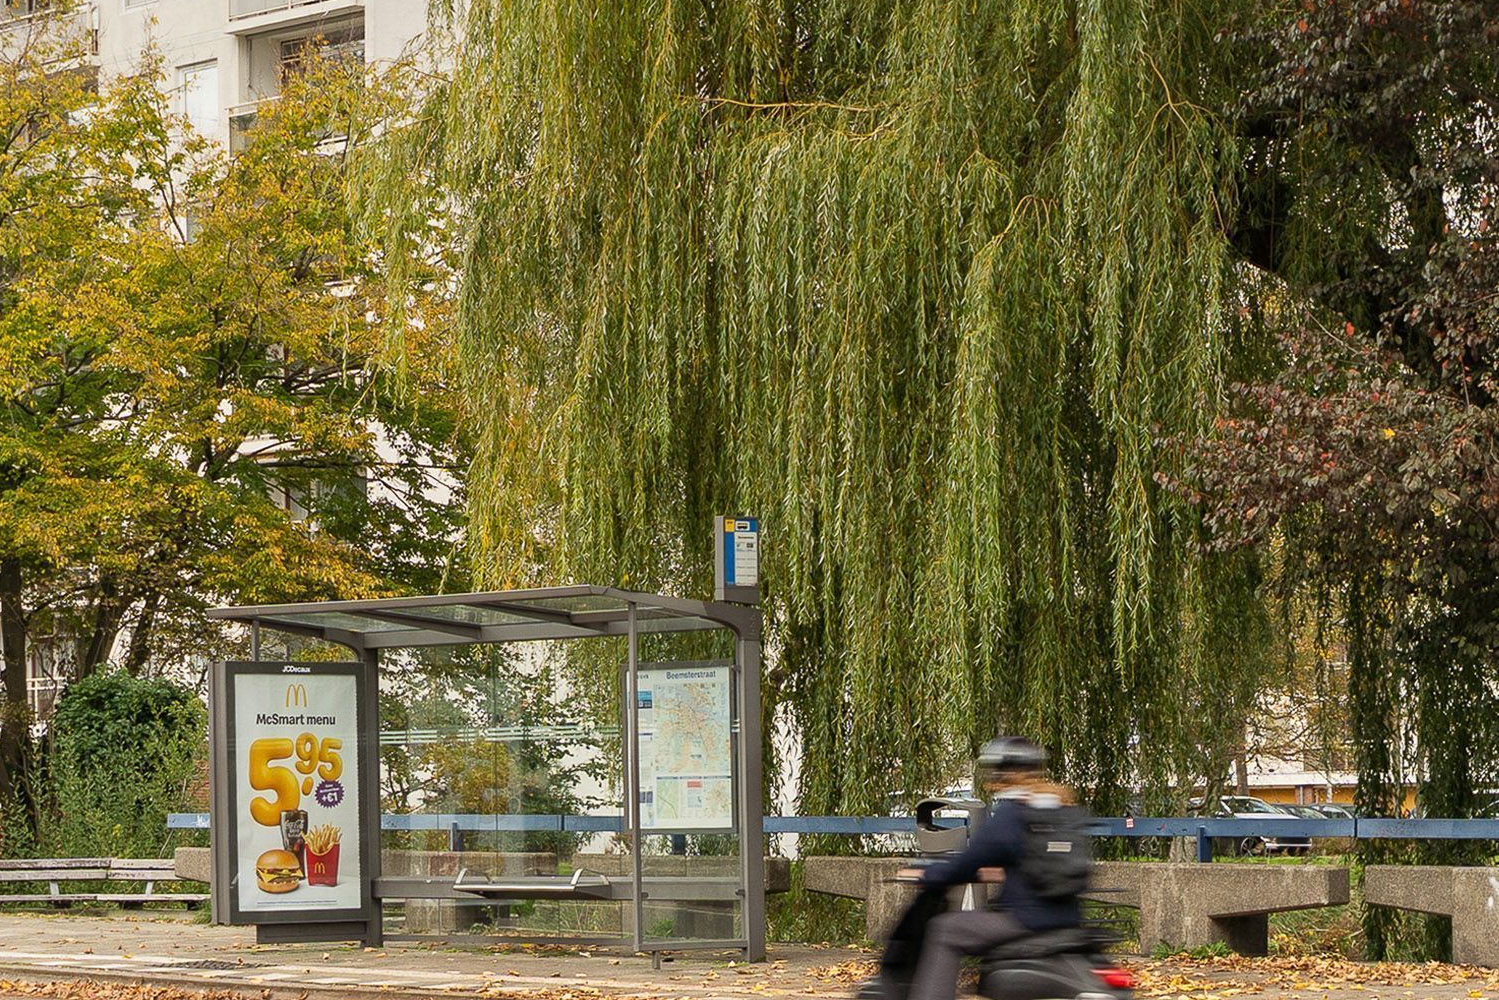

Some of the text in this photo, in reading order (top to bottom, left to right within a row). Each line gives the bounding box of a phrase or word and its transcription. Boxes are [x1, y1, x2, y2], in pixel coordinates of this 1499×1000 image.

[666, 671, 716, 679] Beemsterstraat
[256, 713, 336, 725] McSmart menu
